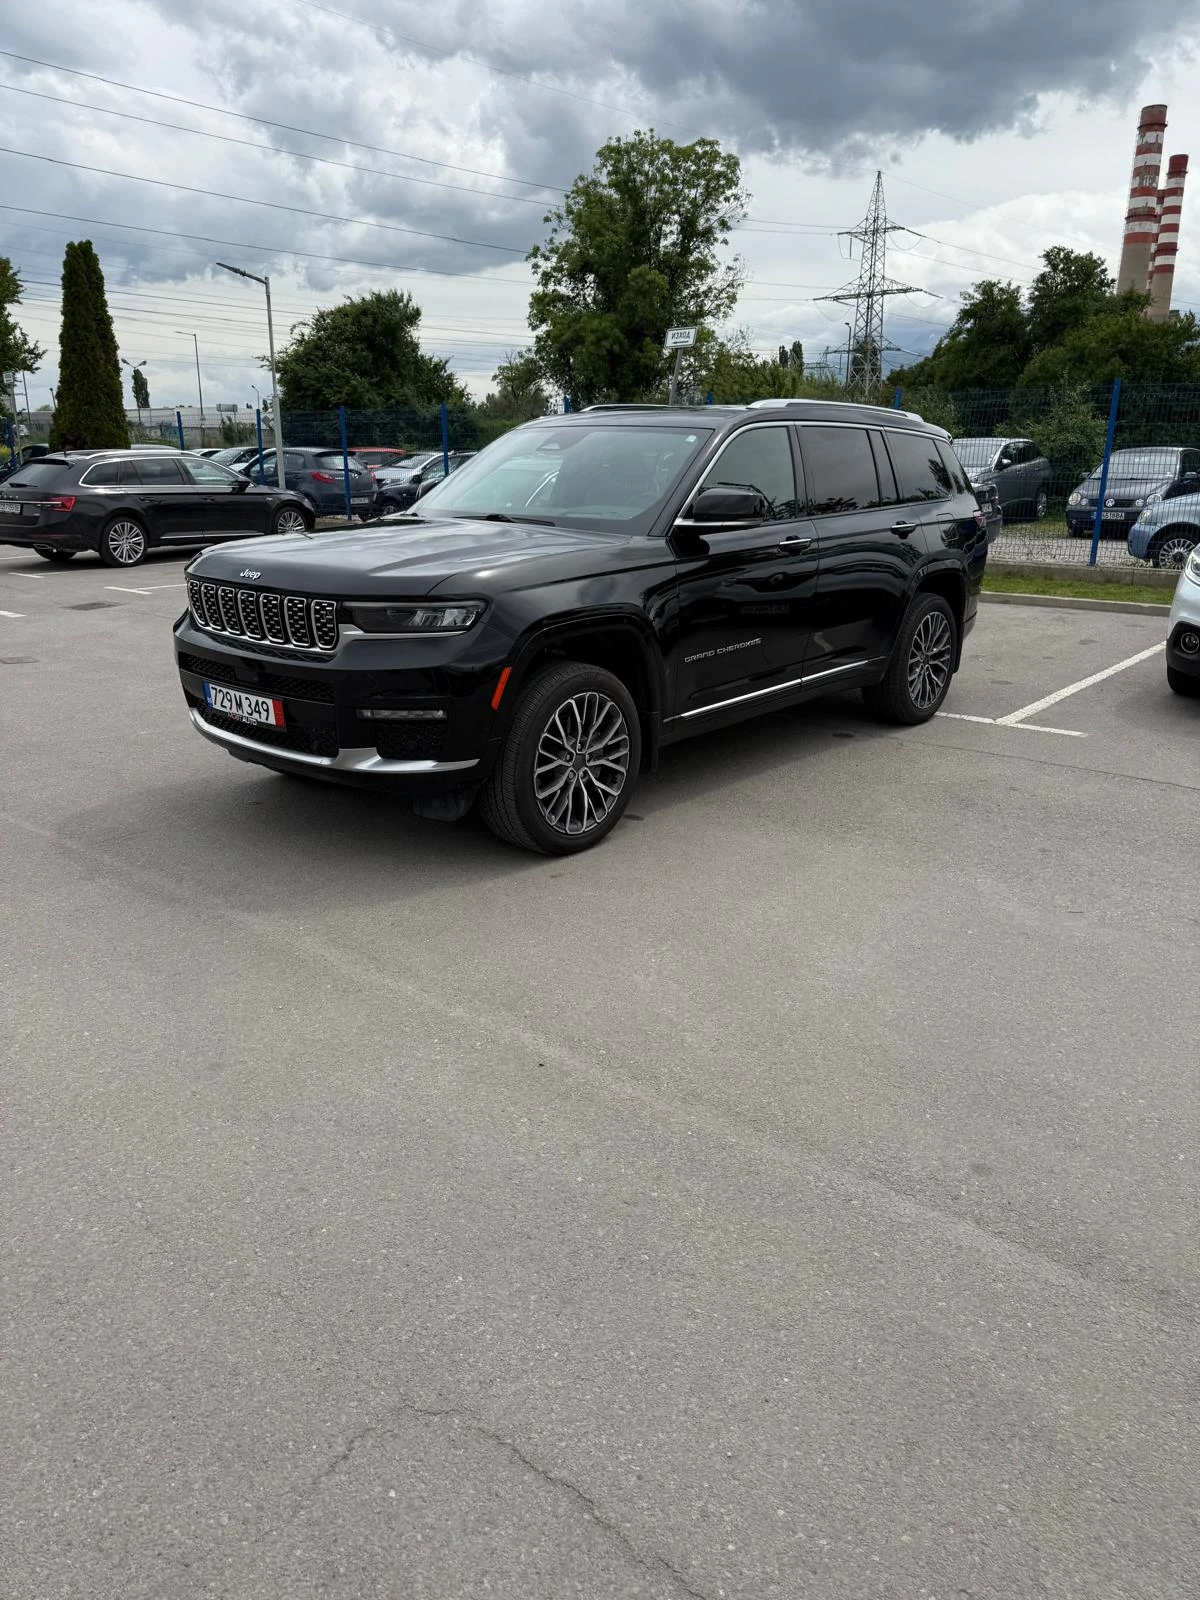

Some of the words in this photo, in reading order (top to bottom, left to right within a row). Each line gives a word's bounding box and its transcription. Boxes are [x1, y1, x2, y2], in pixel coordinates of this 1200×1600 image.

[240, 568, 262, 581] Jeep
[684, 650, 715, 663] GRAND
[716, 637, 763, 655] CHEROKEE
